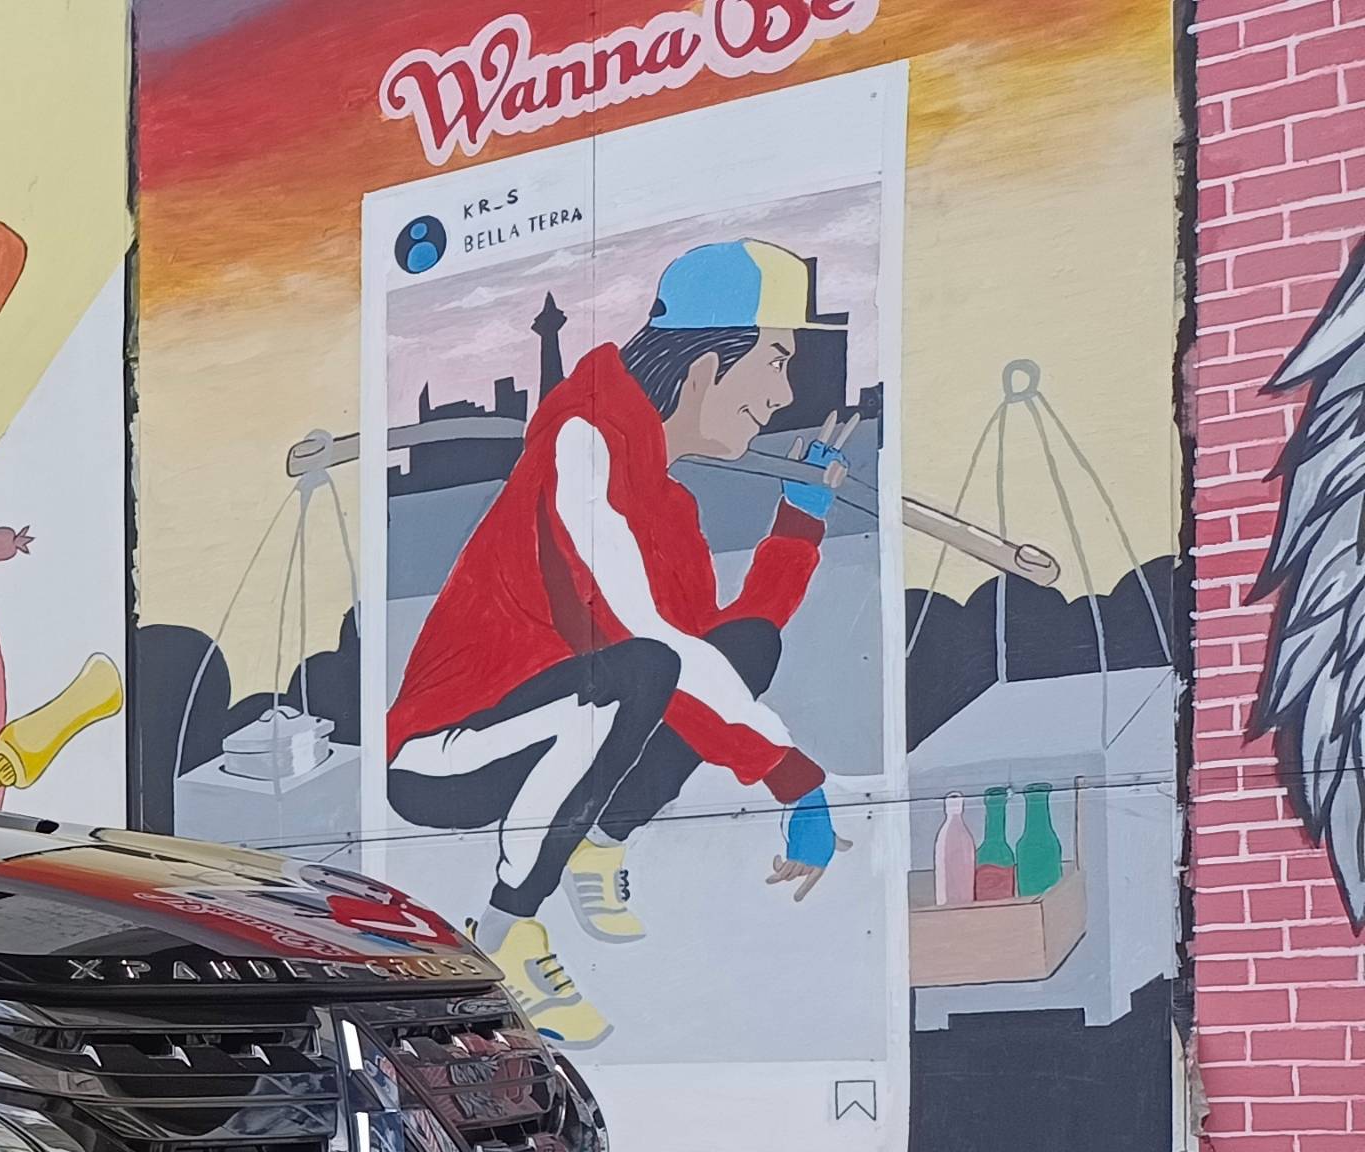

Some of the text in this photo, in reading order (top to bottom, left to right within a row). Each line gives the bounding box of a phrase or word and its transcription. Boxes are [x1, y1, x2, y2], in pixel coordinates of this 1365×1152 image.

[385, 25, 703, 152] Wanna
[463, 188, 519, 220] KR_S
[463, 207, 583, 253] BELLA TERRA
[67, 957, 483, 982] XPANDER CROSS
